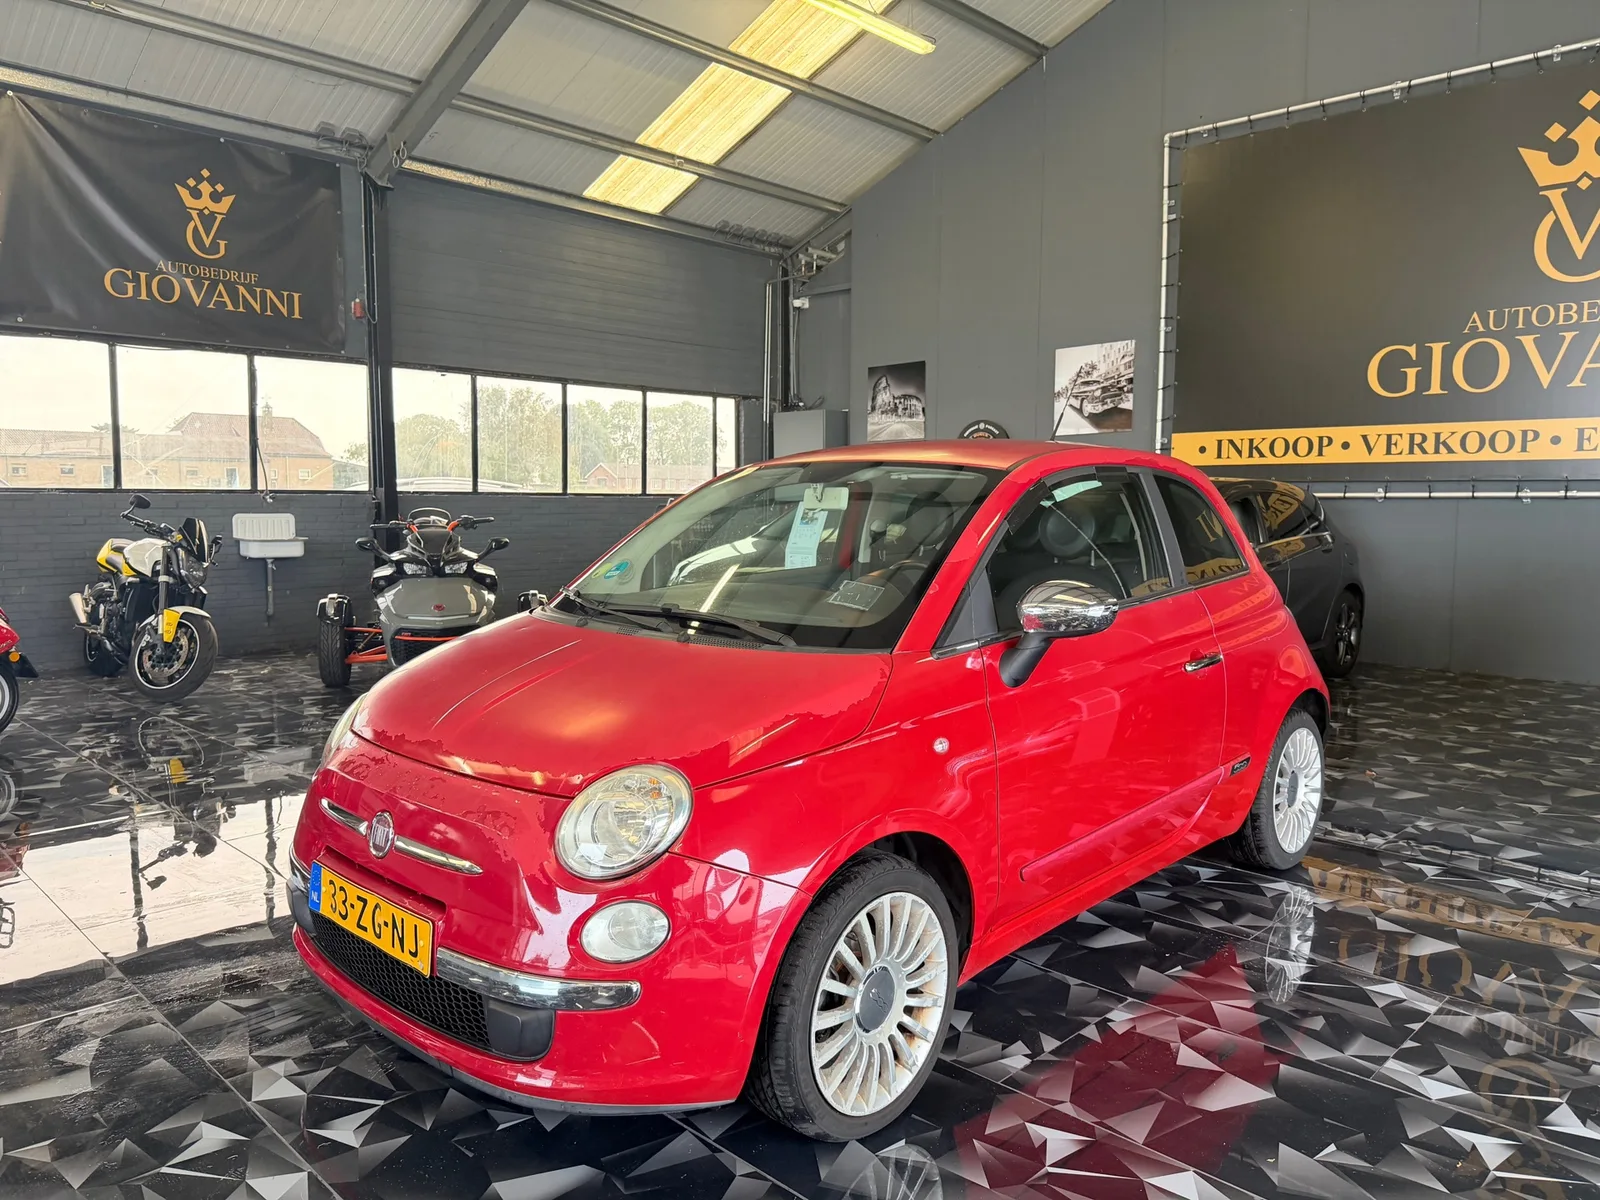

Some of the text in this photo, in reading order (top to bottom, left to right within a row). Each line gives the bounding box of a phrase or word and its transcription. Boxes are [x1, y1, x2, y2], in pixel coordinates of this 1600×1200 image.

[155, 260, 259, 284] AUTOBEDRIJF
[103, 268, 303, 319] GIOVANNI
[1463, 300, 1600, 333] AUTOBE
[1214, 435, 1335, 459] INKOOP
[1360, 428, 1541, 456] VERKOOP
[311, 889, 320, 904] NL
[328, 879, 419, 959] 33-ZG-NJ
